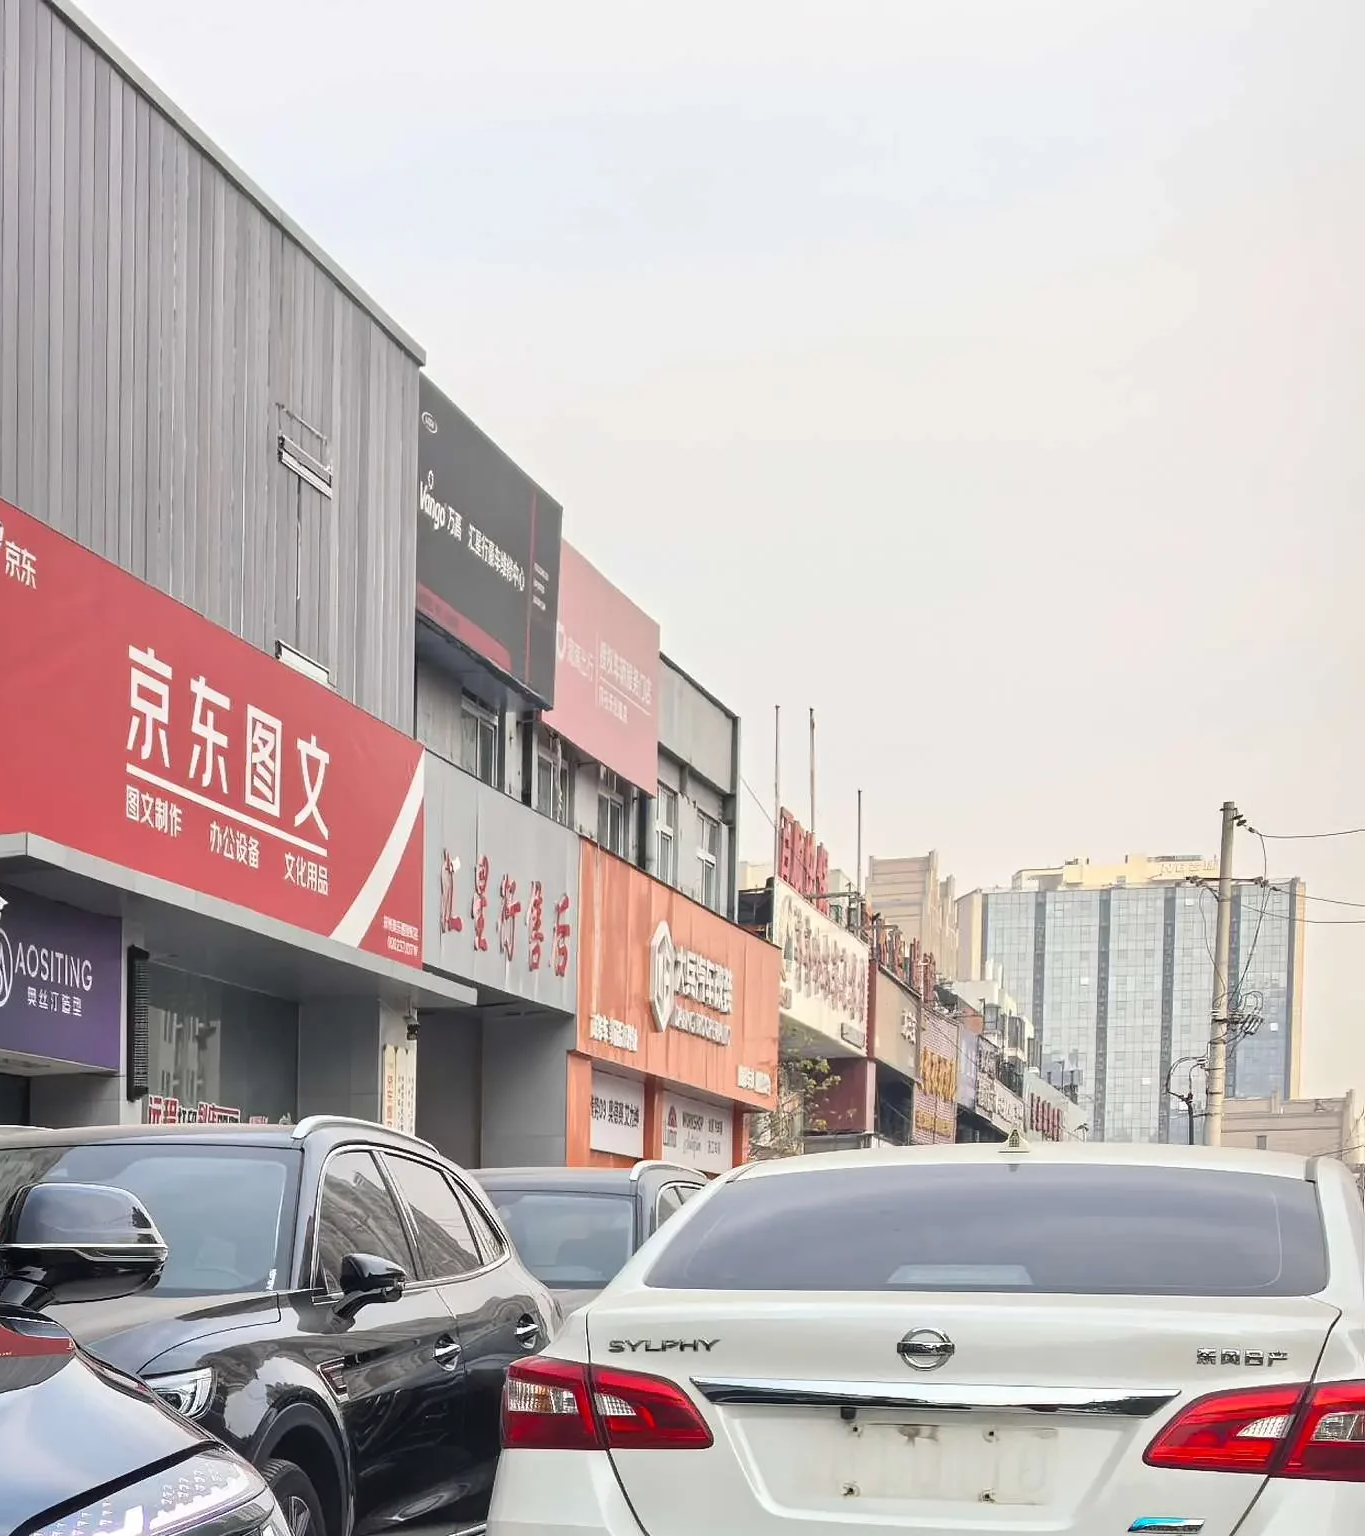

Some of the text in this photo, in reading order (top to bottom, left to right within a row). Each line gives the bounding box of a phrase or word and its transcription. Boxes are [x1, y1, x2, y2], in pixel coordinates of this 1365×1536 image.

[4, 539, 37, 590] 京东
[126, 645, 330, 840] 京东图文
[126, 784, 329, 896] 图文制作 办公设备 文化用品
[14, 942, 93, 992] AOSITING
[27, 986, 83, 1017] 奥丝汀造型
[608, 1338, 721, 1354] SYLPHY
